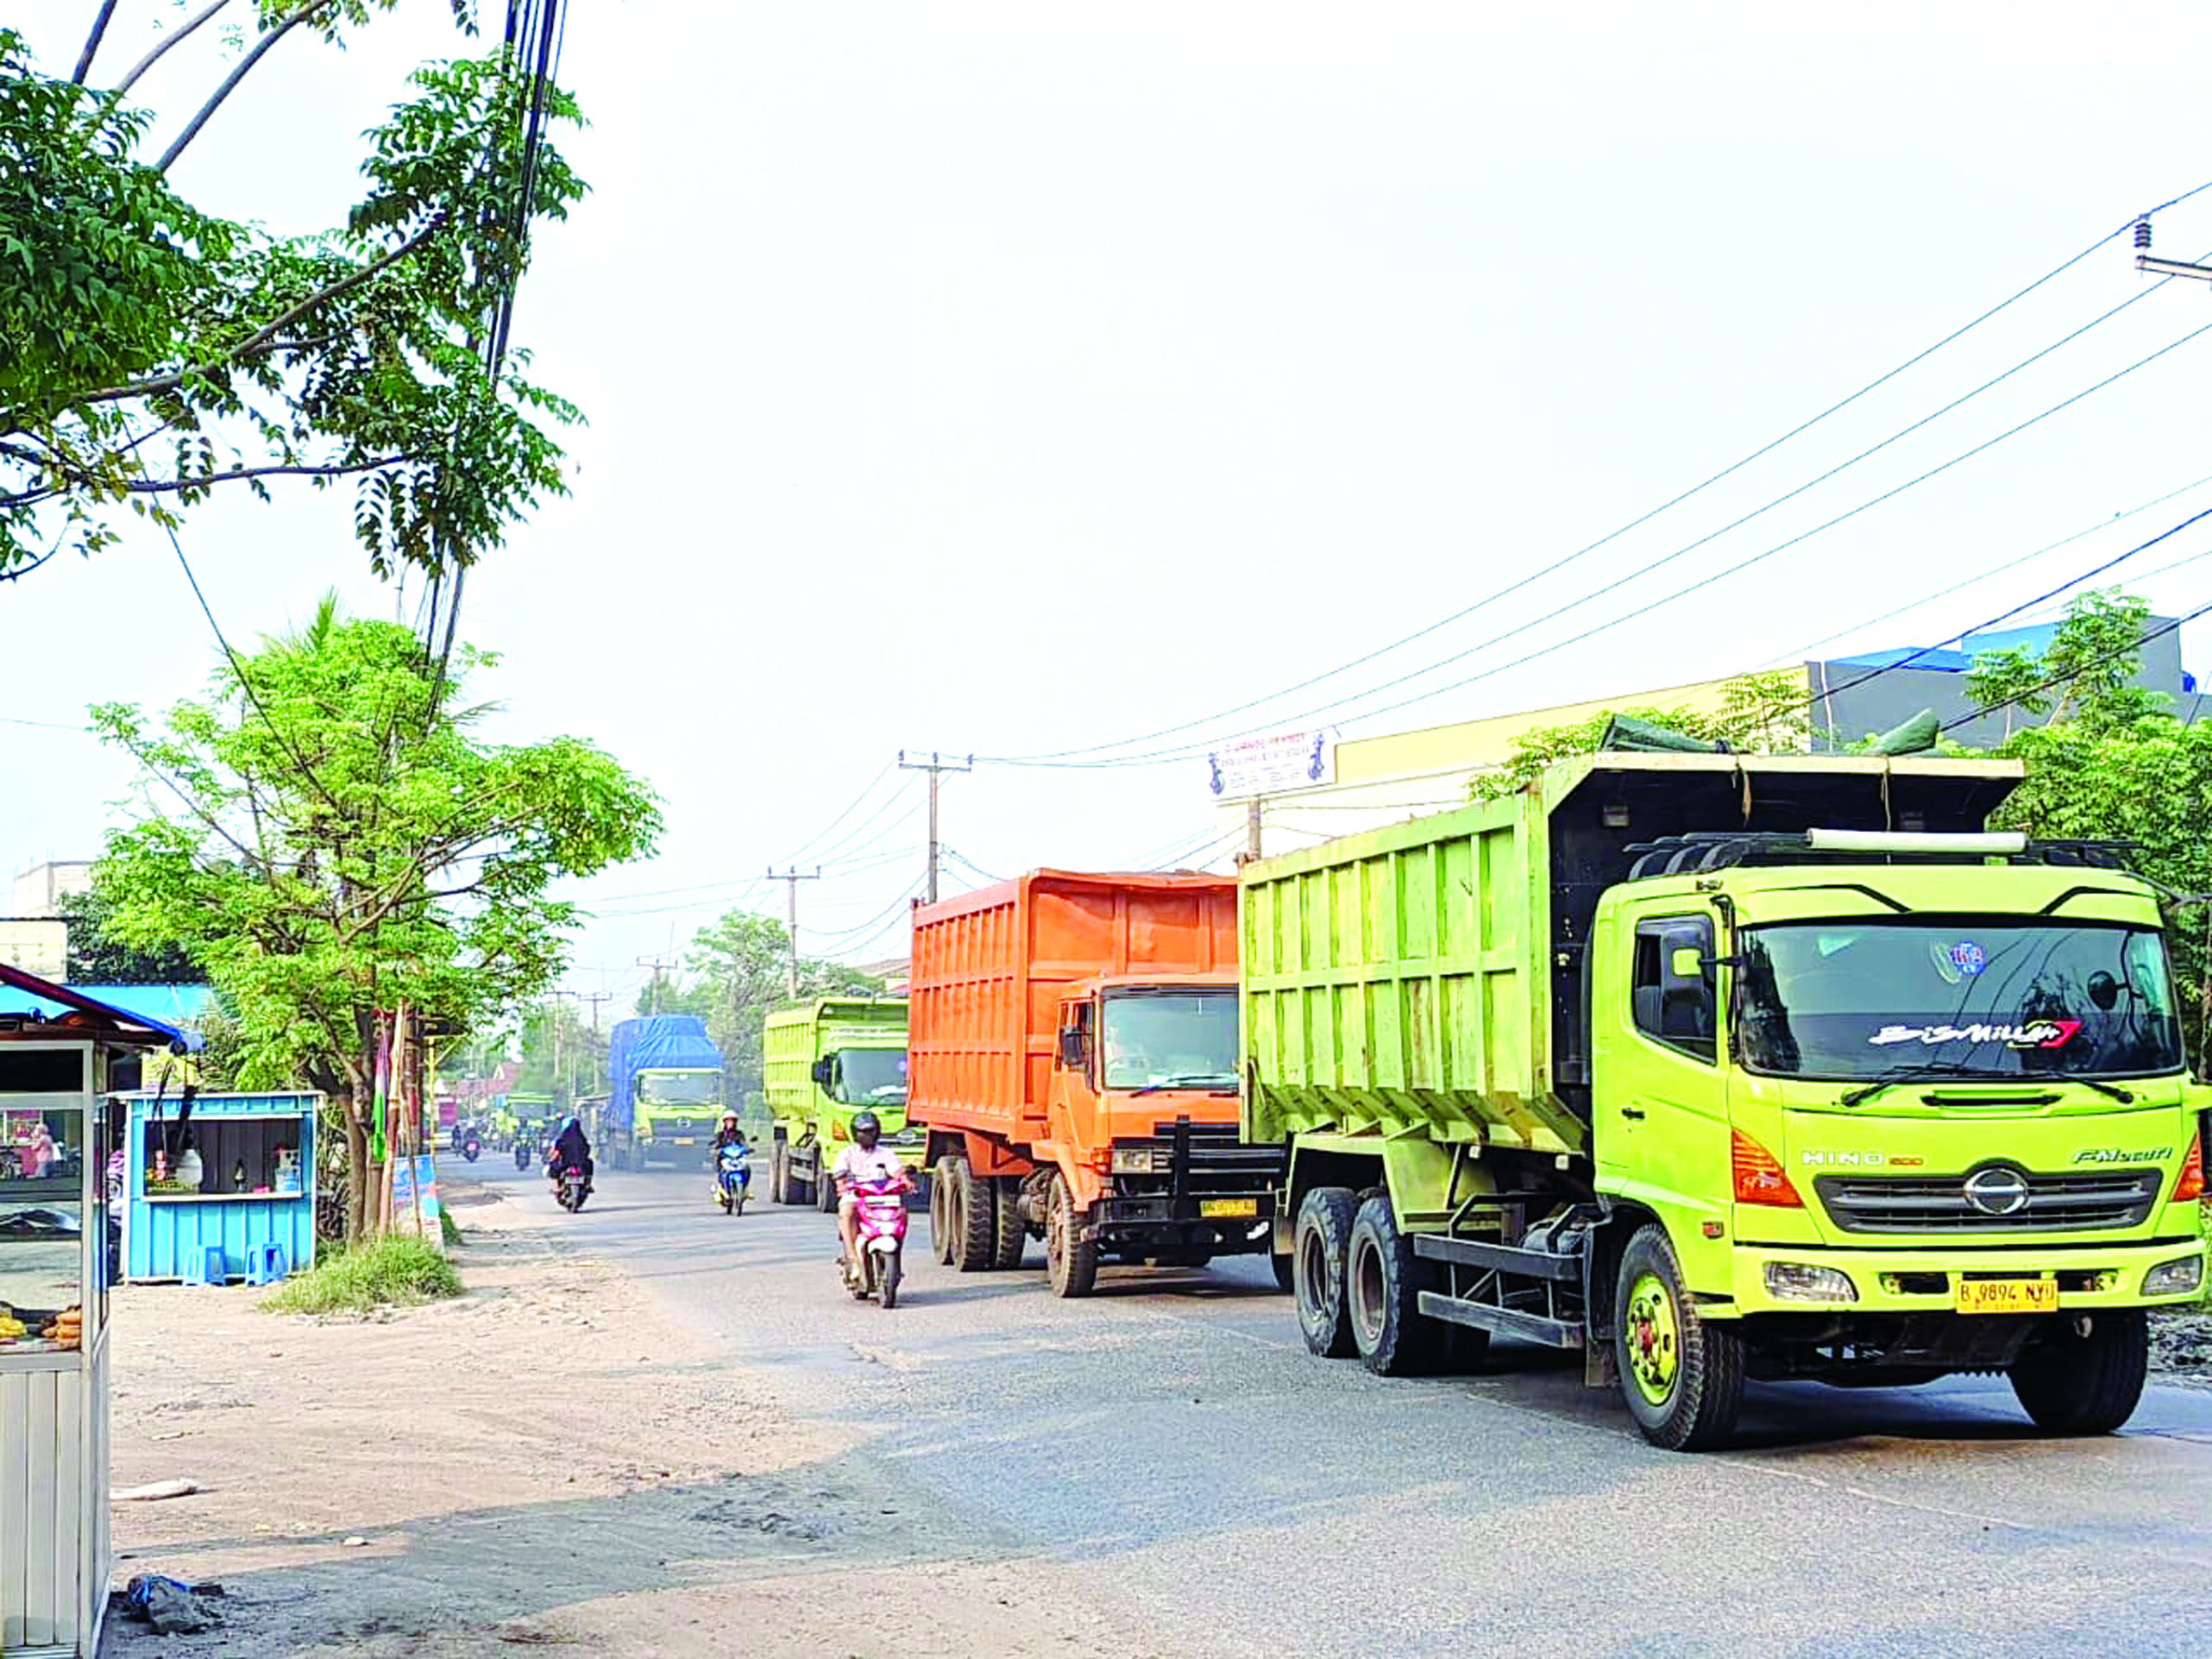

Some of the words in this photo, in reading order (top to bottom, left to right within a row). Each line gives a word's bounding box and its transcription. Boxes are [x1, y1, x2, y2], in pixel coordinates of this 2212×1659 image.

[1802, 1151, 1883, 1166] HINO
[1961, 1283, 1971, 1301] B
[1979, 1283, 2017, 1301] 9894
